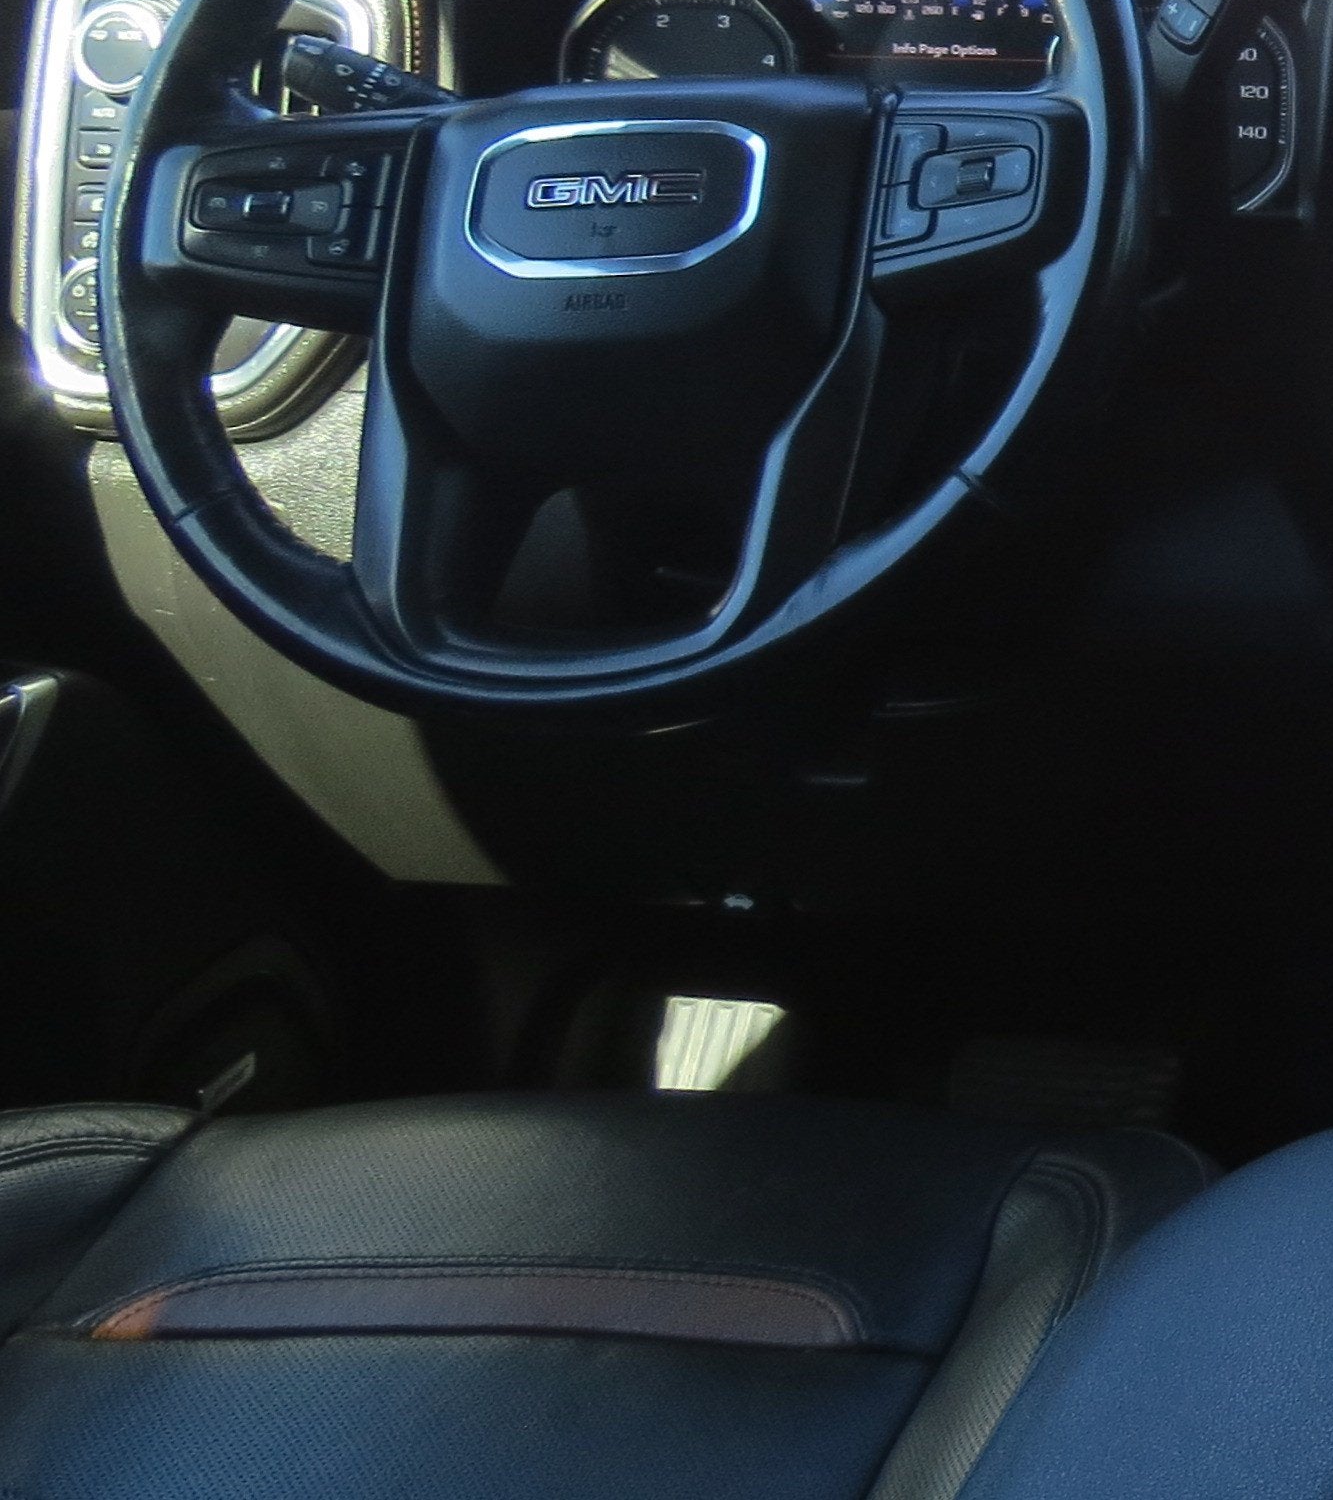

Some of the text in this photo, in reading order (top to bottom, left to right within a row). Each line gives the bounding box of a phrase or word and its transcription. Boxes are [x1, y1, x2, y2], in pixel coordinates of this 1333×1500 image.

[654, 13, 671, 28] 2
[717, 14, 731, 28] 3
[892, 43, 999, 59] Info Page Options
[760, 54, 775, 67] 4
[1239, 85, 1270, 100] 120
[1238, 125, 1268, 140] 140
[526, 169, 706, 210] GMC
[563, 292, 628, 311] AIRBAG
